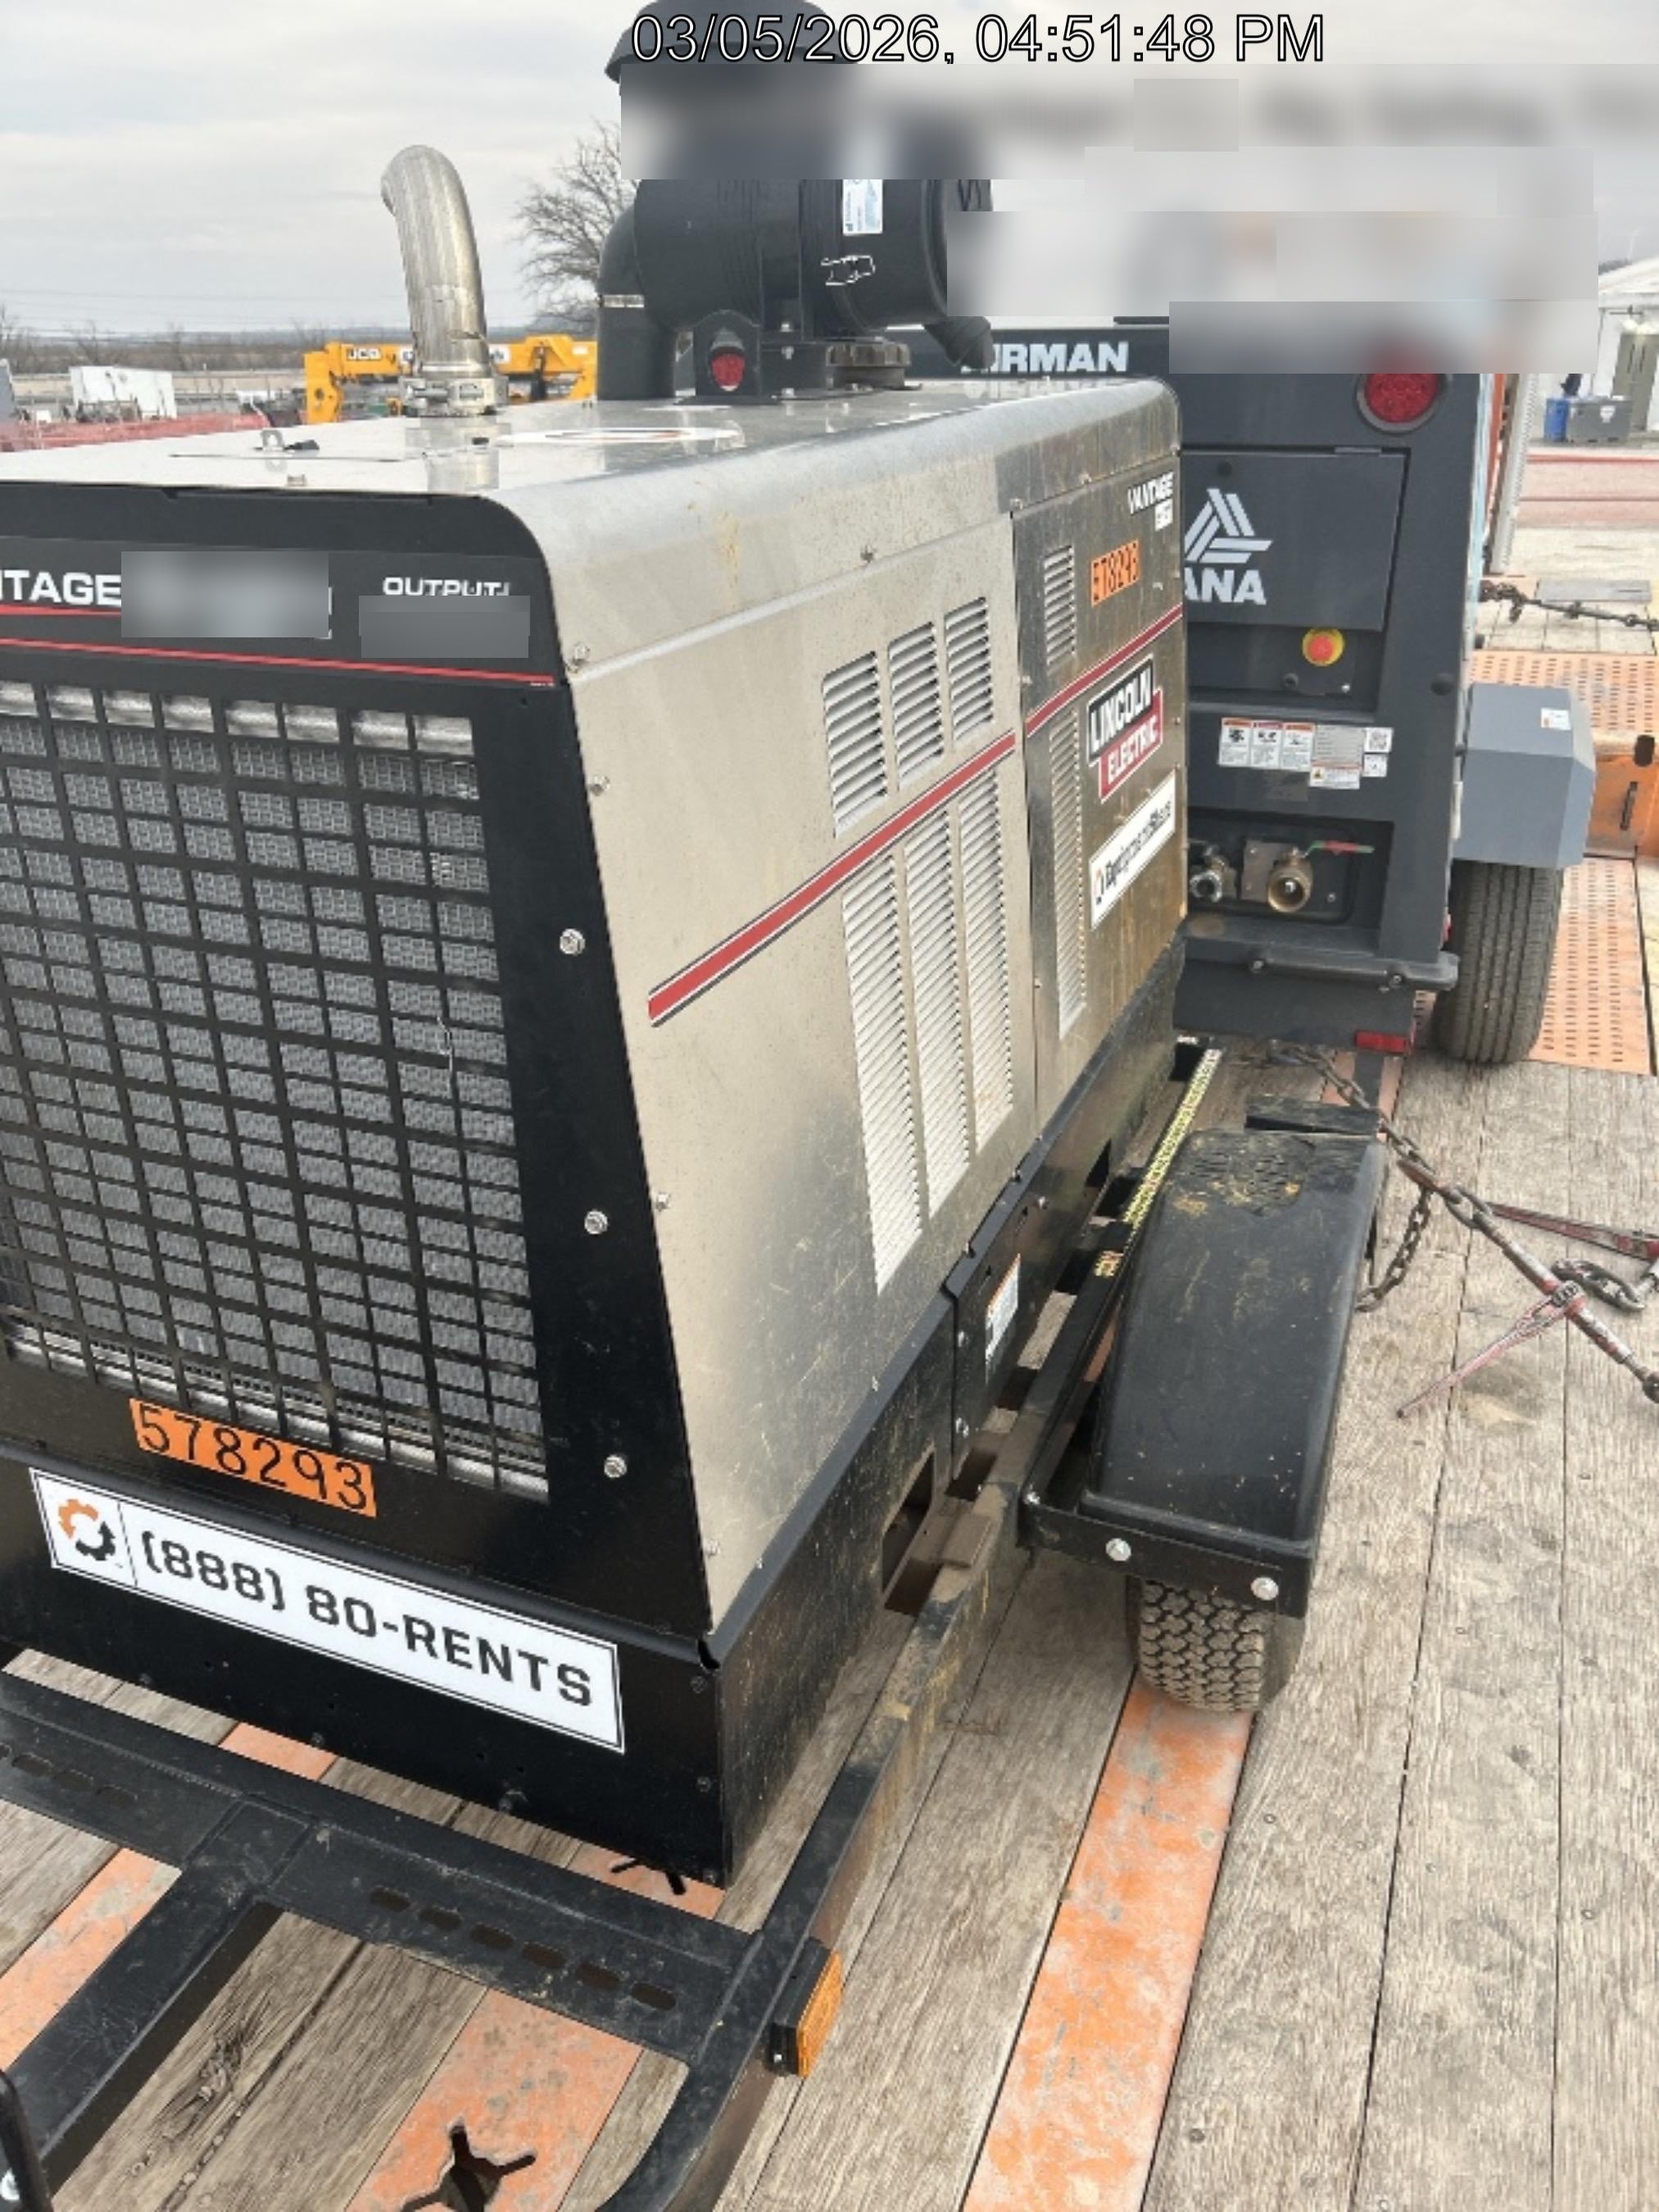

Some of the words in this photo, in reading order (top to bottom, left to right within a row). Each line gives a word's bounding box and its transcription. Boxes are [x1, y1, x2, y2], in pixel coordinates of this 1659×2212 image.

[1091, 667, 1152, 755] LINCOLN
[1108, 714, 1158, 786] ELECTRIC
[138, 1402, 369, 1512] 578293
[141, 1529, 287, 1612] (888)
[306, 1584, 593, 1707] 80-RENTS
